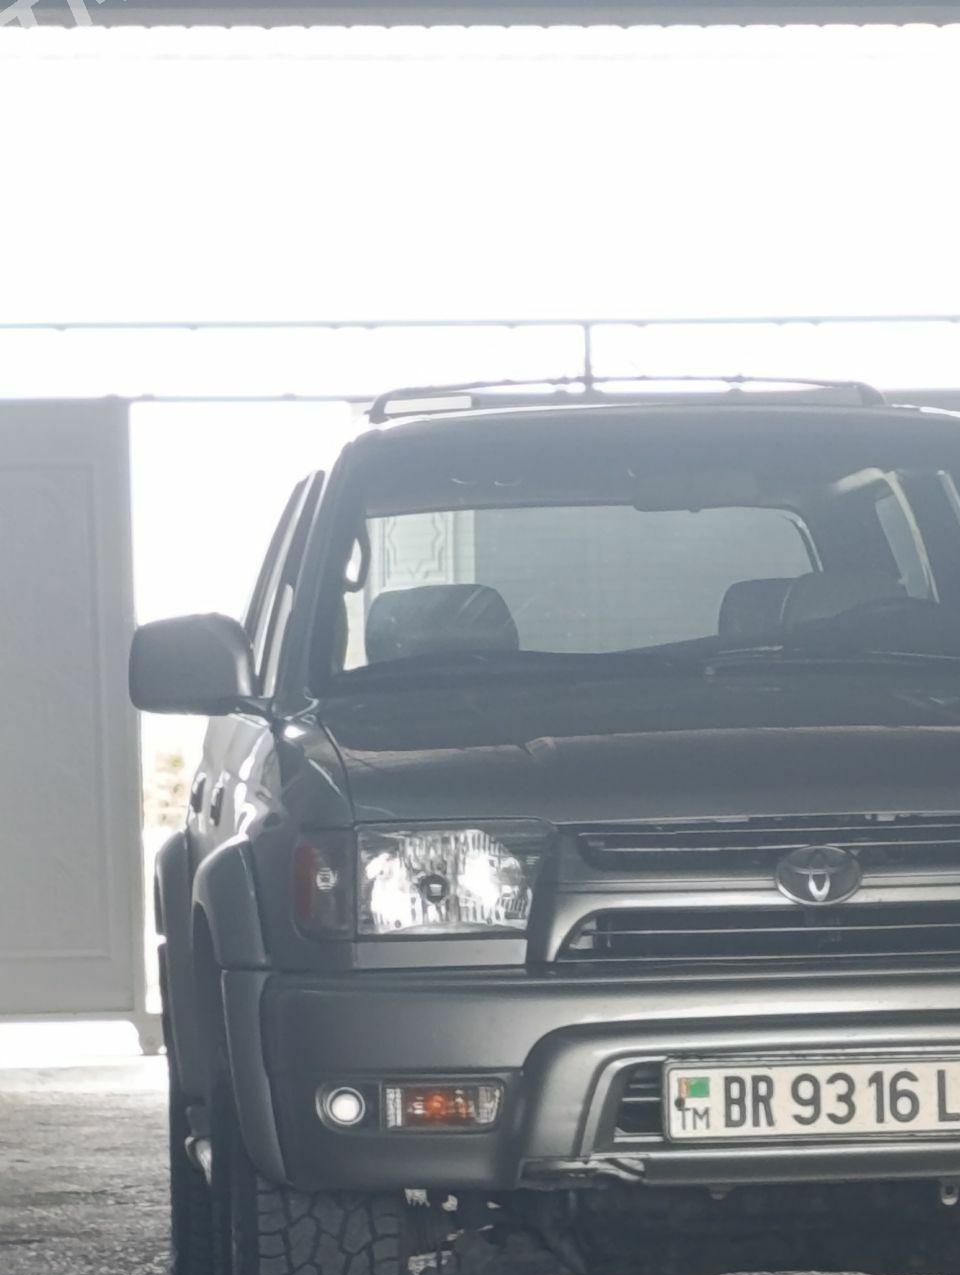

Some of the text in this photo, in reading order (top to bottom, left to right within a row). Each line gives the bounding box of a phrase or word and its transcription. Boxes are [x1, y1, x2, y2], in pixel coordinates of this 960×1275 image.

[677, 1106, 711, 1131] TM
[723, 1075, 775, 1128] BR
[790, 1070, 920, 1126] 9316
